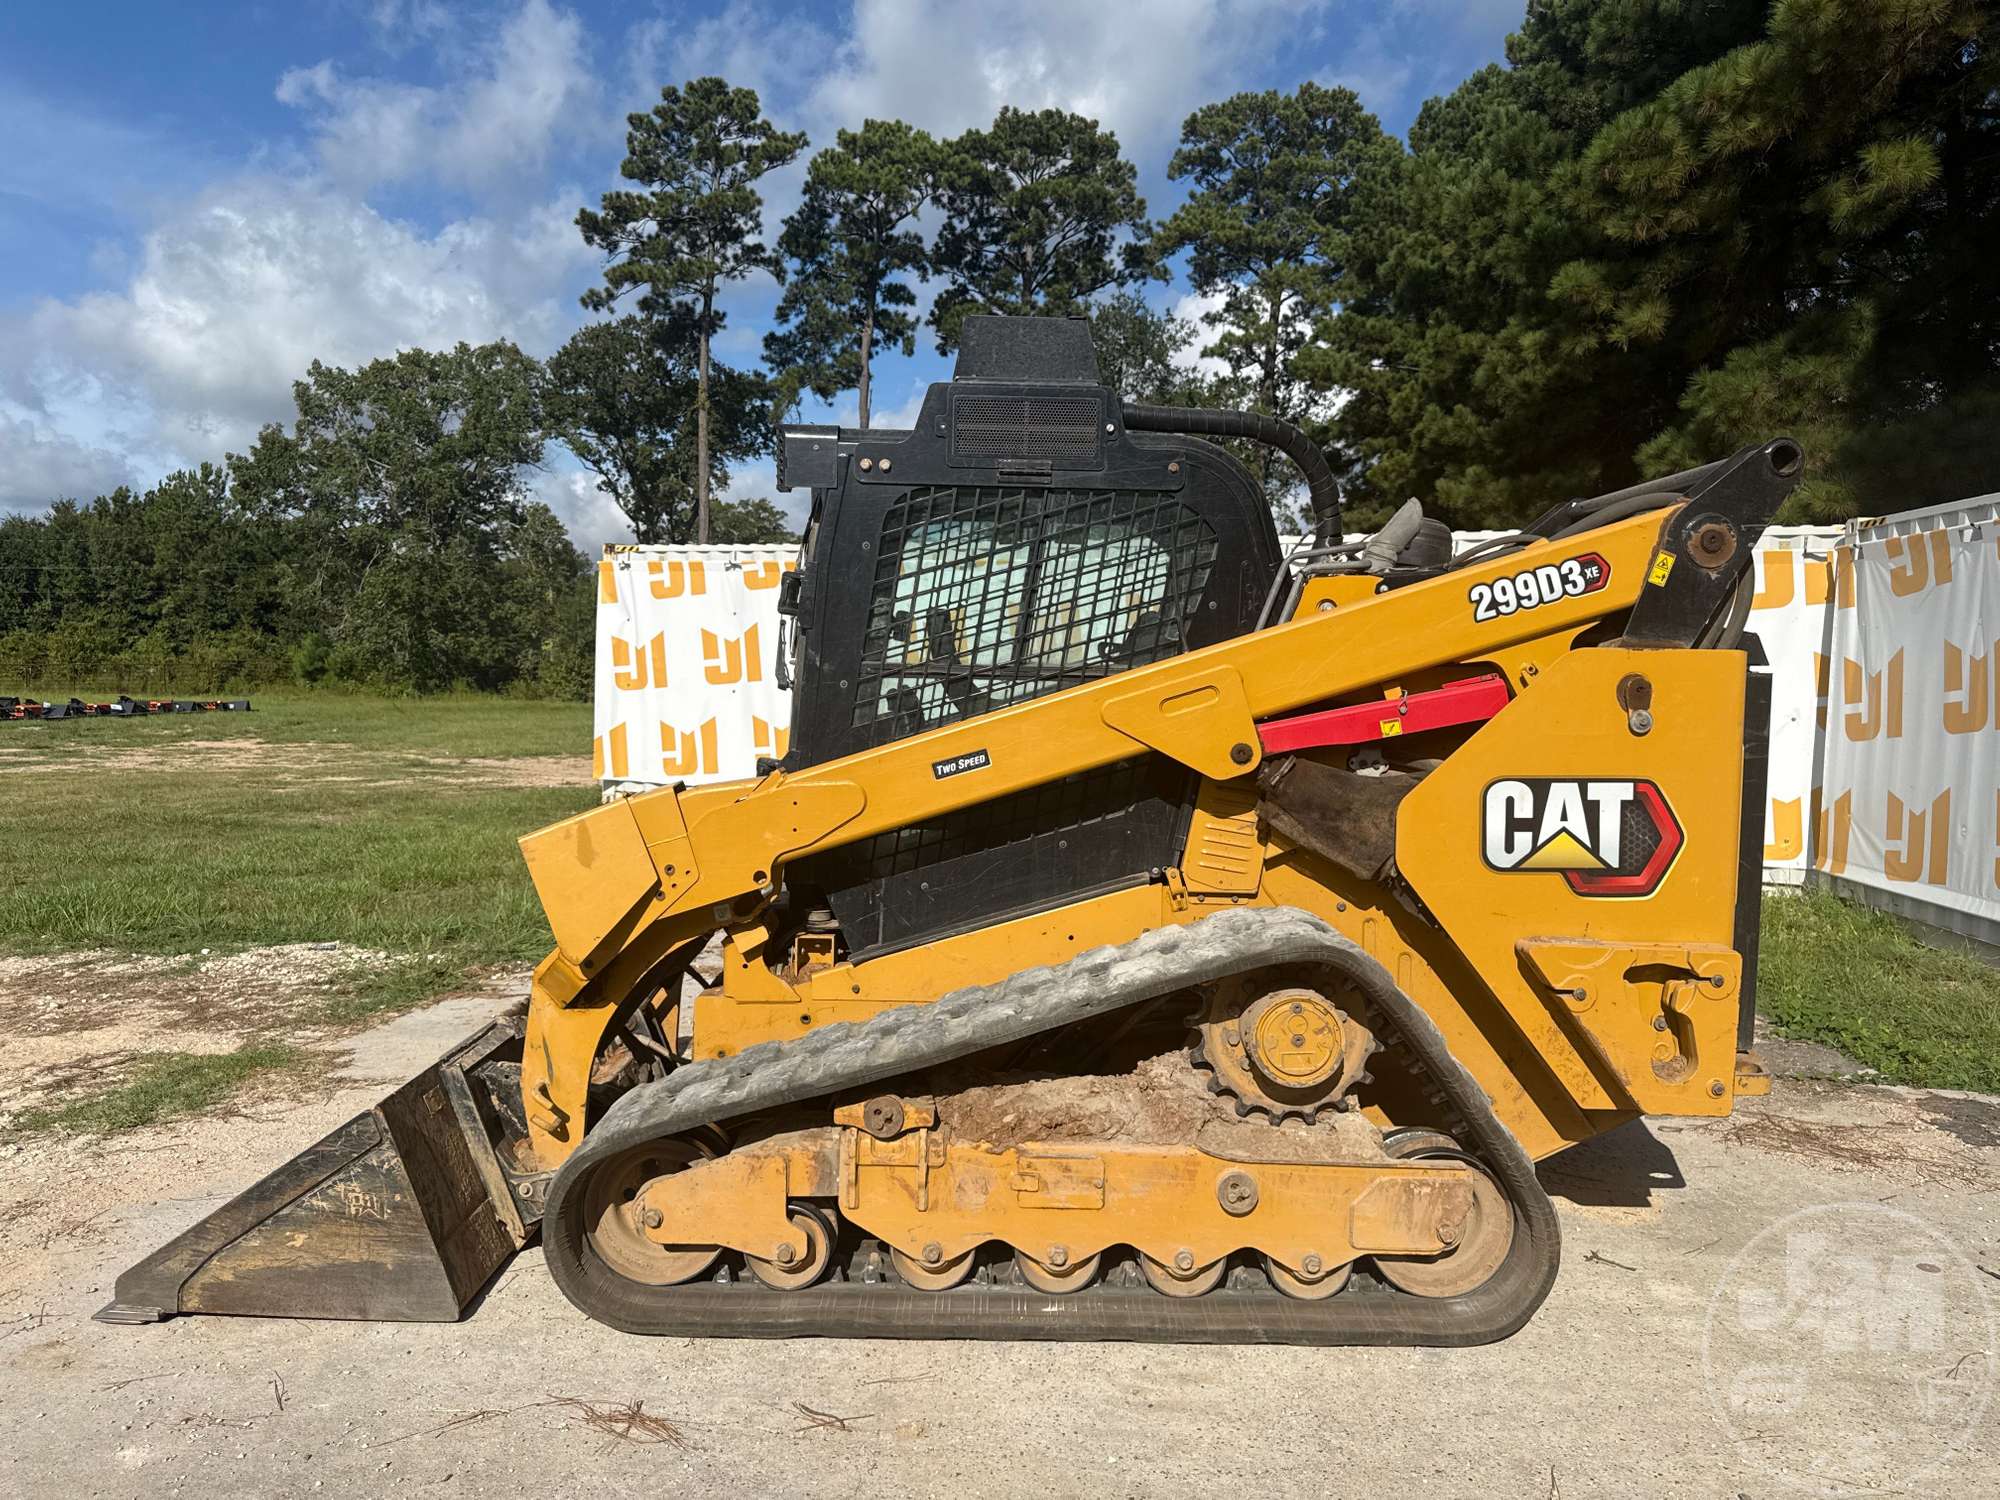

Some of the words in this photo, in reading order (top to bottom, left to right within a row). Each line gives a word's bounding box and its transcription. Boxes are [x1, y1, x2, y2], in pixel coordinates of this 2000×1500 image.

[1470, 559, 1586, 622] 299D3
[1584, 566, 1600, 580] XE
[1486, 780, 1634, 869] CAT
